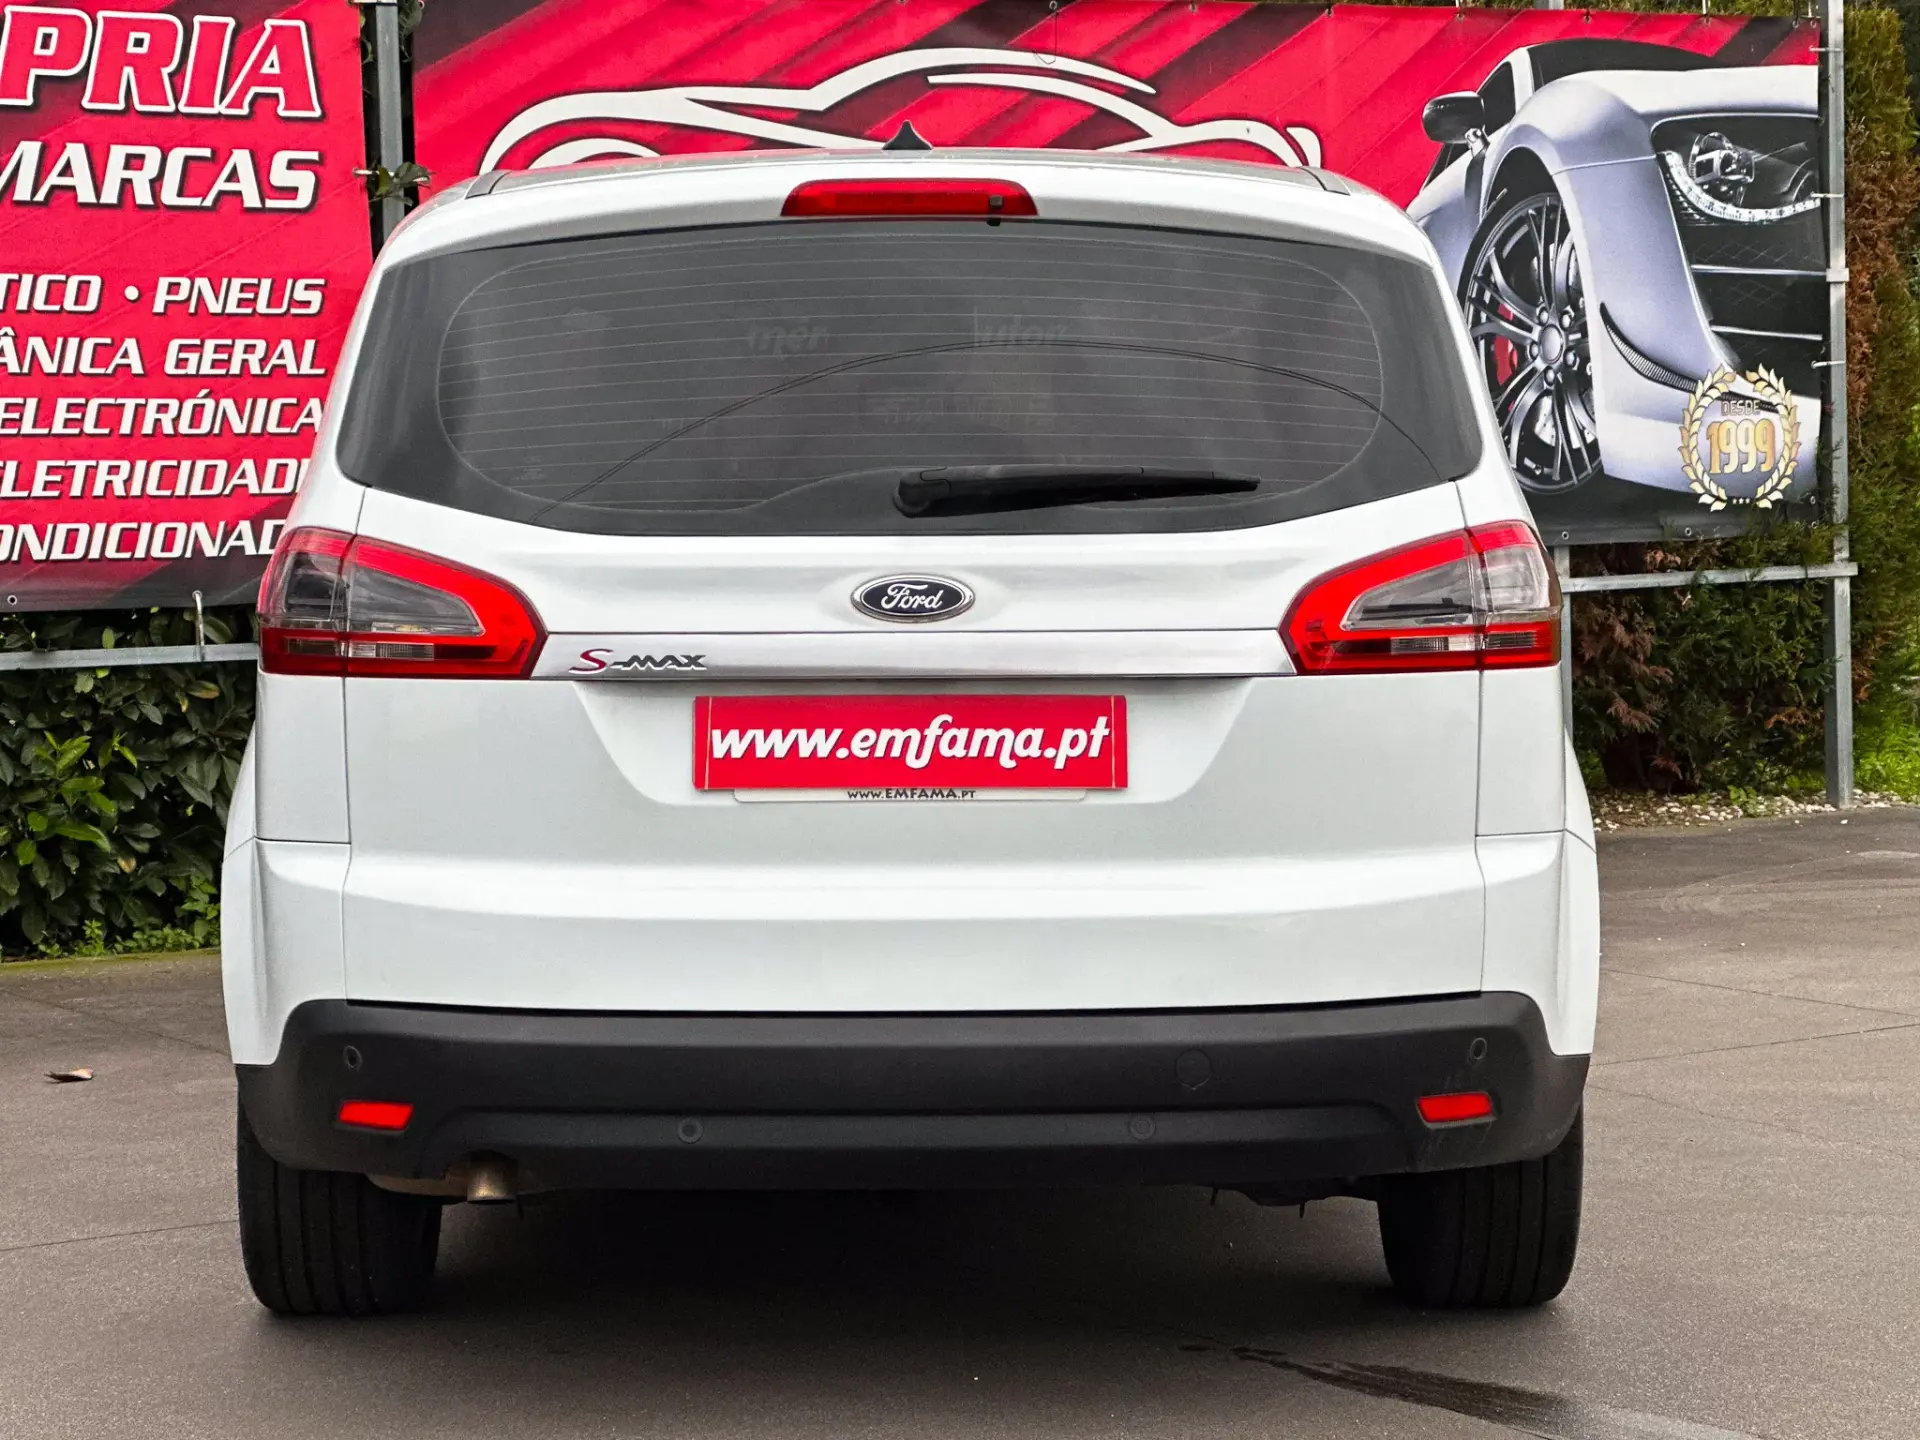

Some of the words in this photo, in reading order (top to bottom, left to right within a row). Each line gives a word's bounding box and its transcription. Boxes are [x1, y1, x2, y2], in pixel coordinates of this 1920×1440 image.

[0, 5, 322, 118] PRIA
[152, 277, 326, 315] PNEUS
[164, 338, 326, 375] GERAL
[0, 389, 322, 435] ELECTRÓNICA
[1721, 400, 1761, 416] DESDE
[1706, 418, 1776, 474] 1999
[0, 458, 311, 498] LETRICIDAD
[881, 583, 945, 609] Ford
[568, 648, 707, 675] S-MAX
[710, 714, 1112, 769] www.emfama.pt
